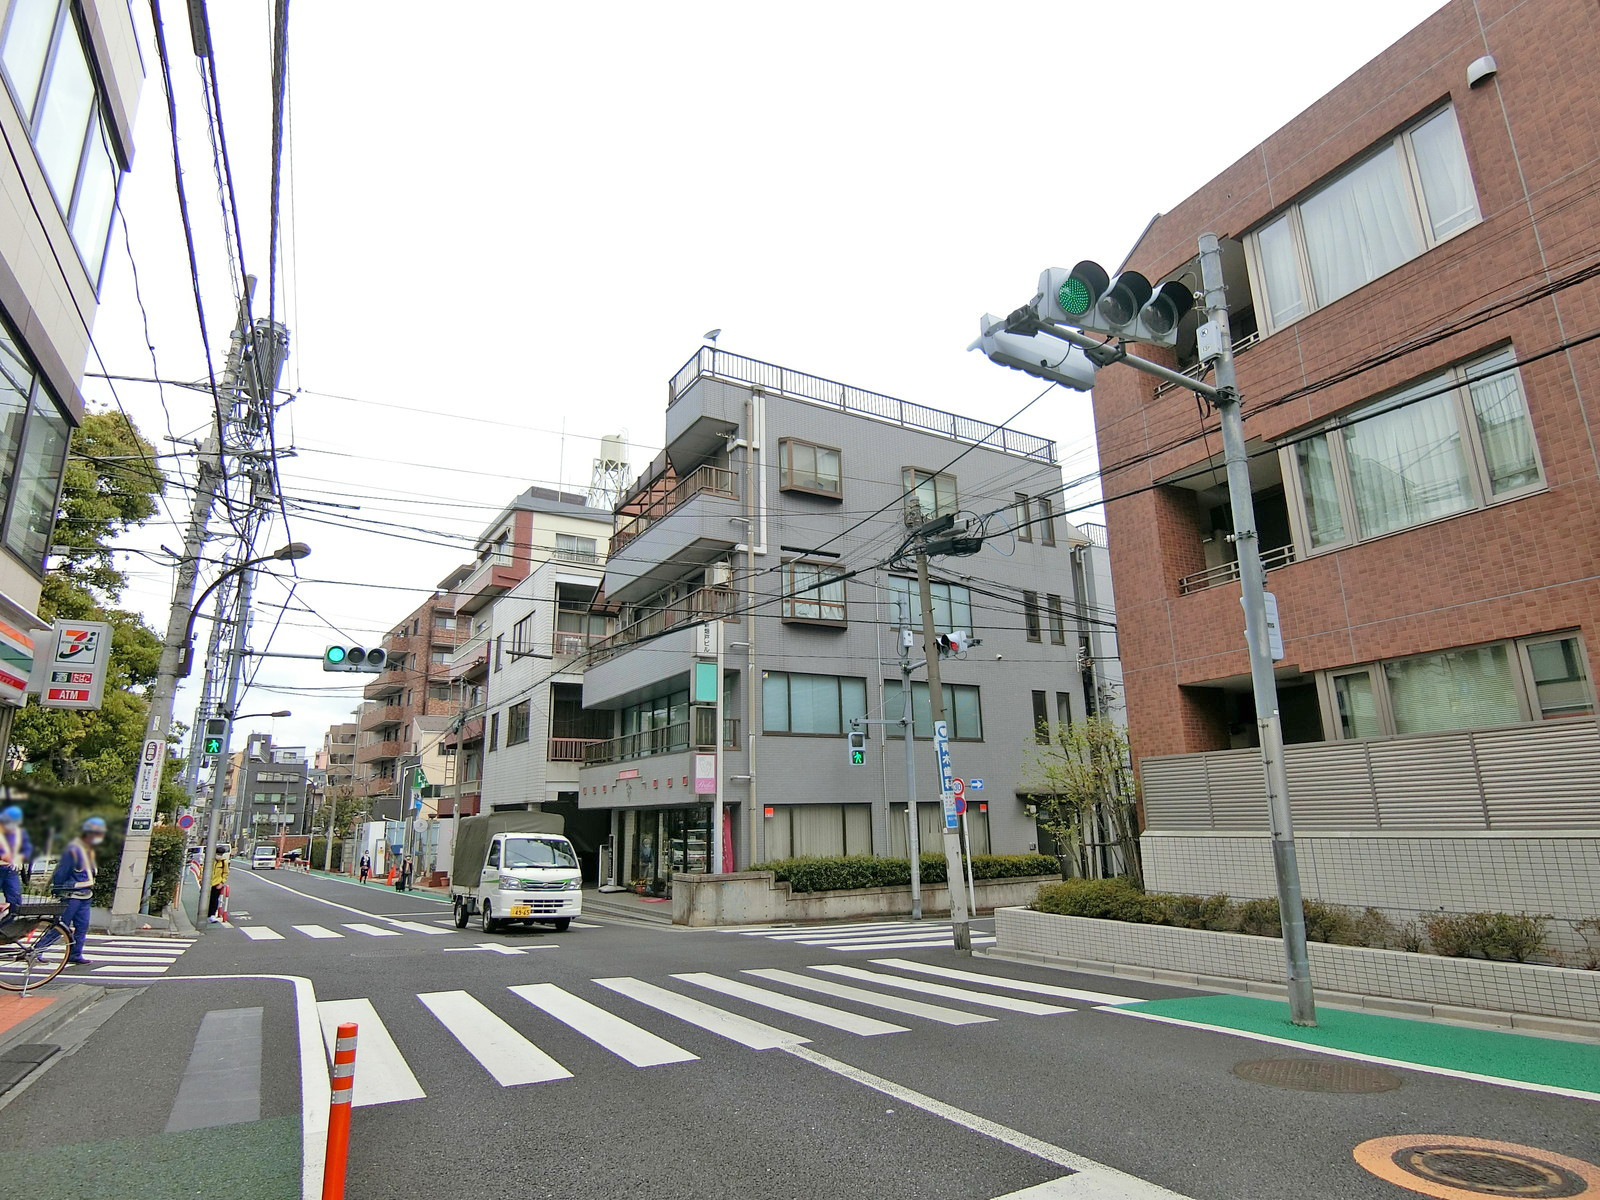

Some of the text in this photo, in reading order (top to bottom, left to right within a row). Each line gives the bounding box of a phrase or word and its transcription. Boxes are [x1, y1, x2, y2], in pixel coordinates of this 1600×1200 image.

[73, 674, 90, 683] たばこ
[59, 690, 78, 699] ATM
[954, 783, 962, 791] 30
